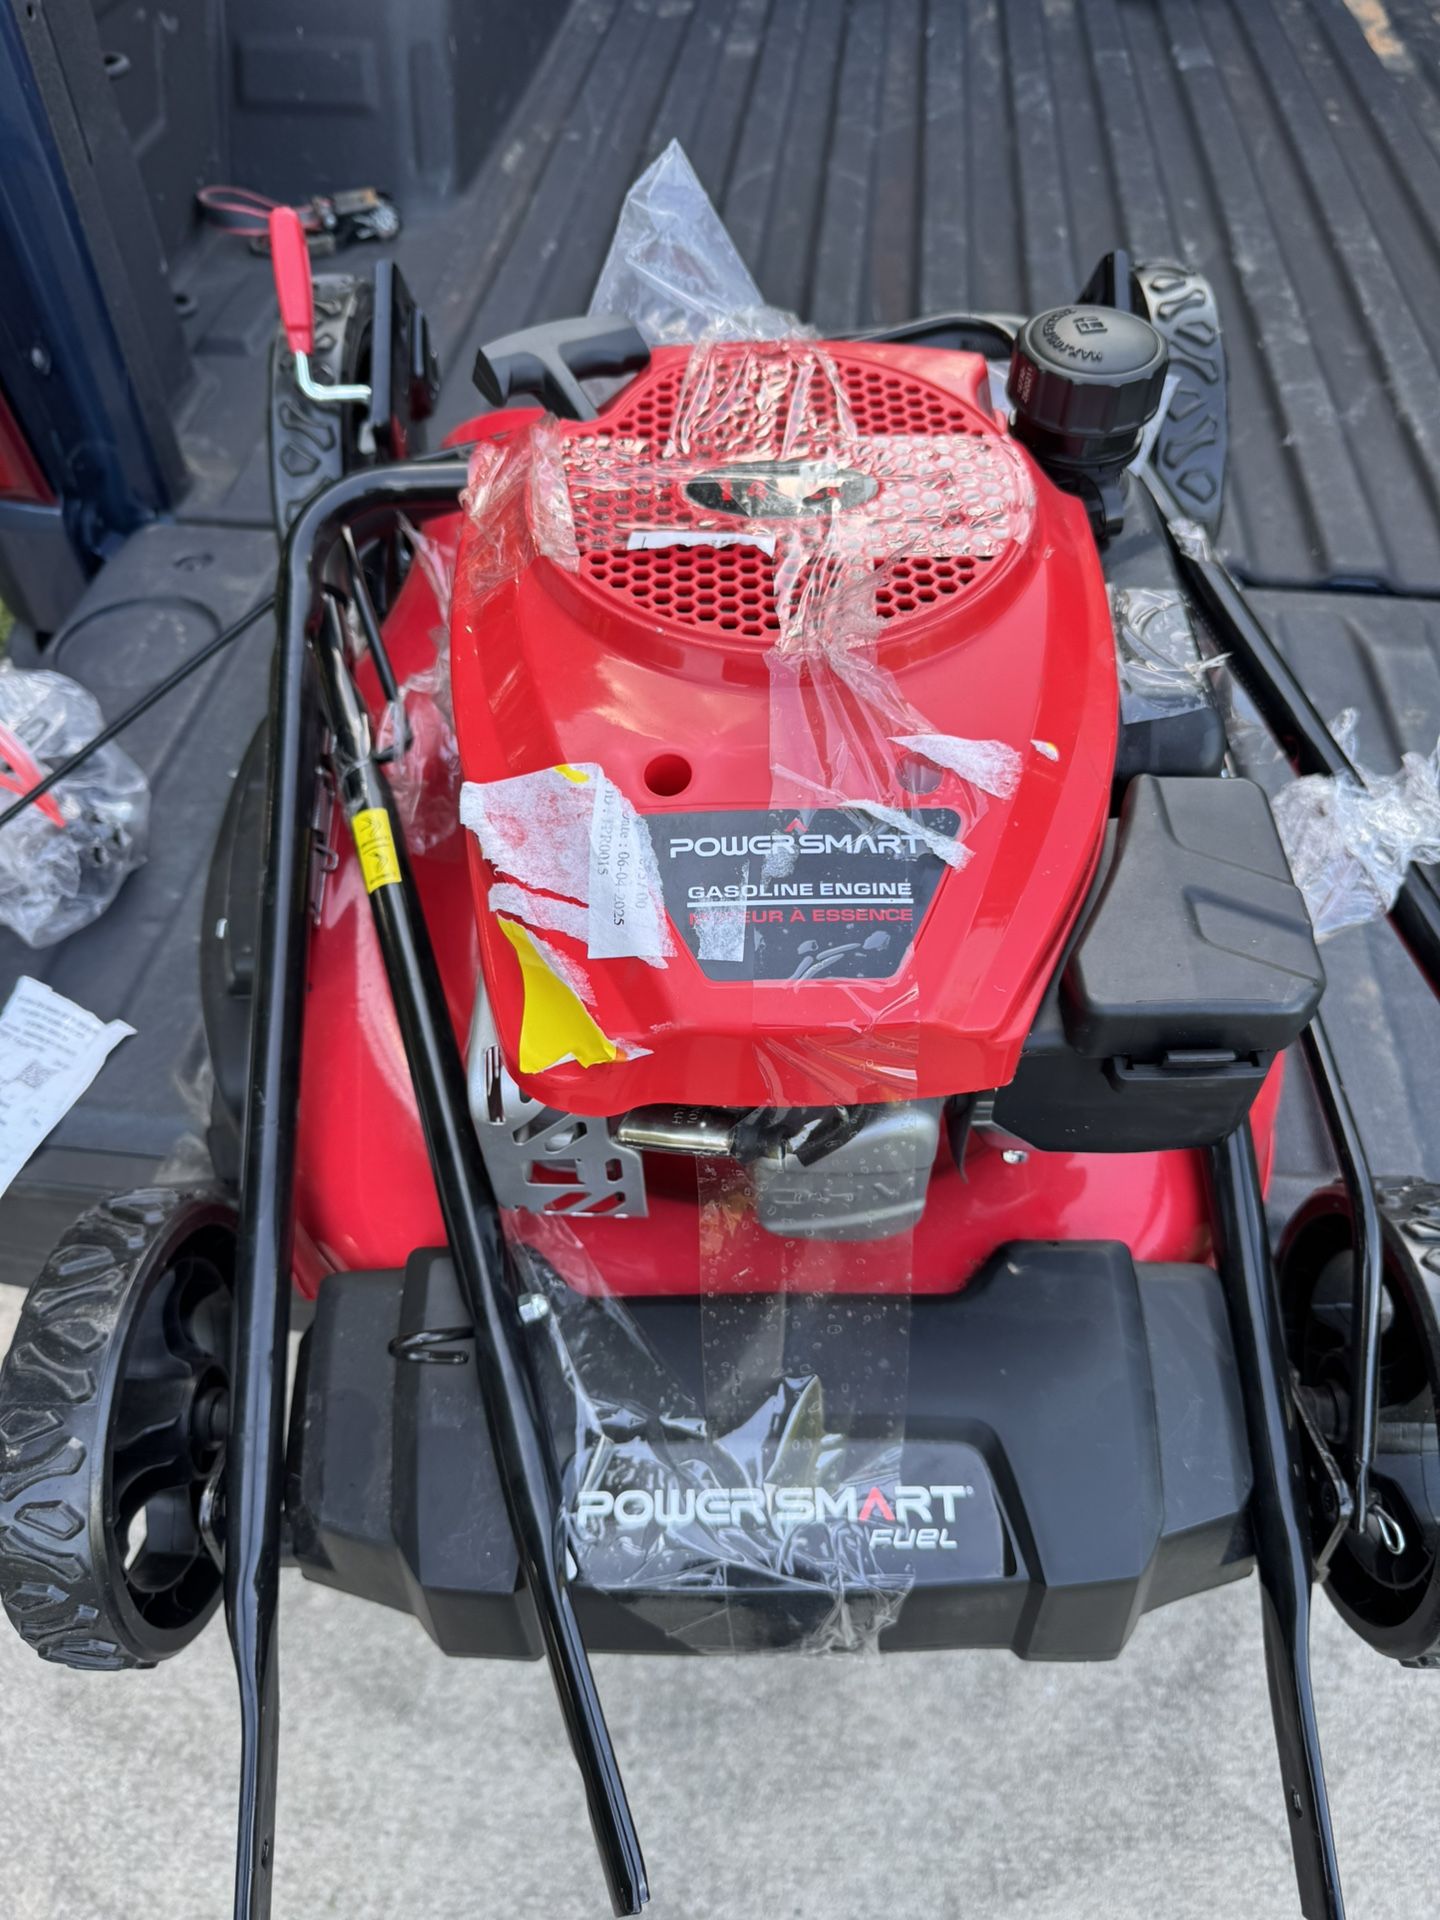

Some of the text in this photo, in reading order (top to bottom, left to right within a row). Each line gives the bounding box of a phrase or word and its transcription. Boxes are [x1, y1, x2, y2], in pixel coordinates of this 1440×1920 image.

[669, 833, 925, 858] POWERSMART
[687, 882, 913, 899] GASOLINE ENGINE
[789, 906, 807, 923] À
[812, 908, 913, 922] ESSENCE
[577, 1485, 966, 1531] POWERSMART
